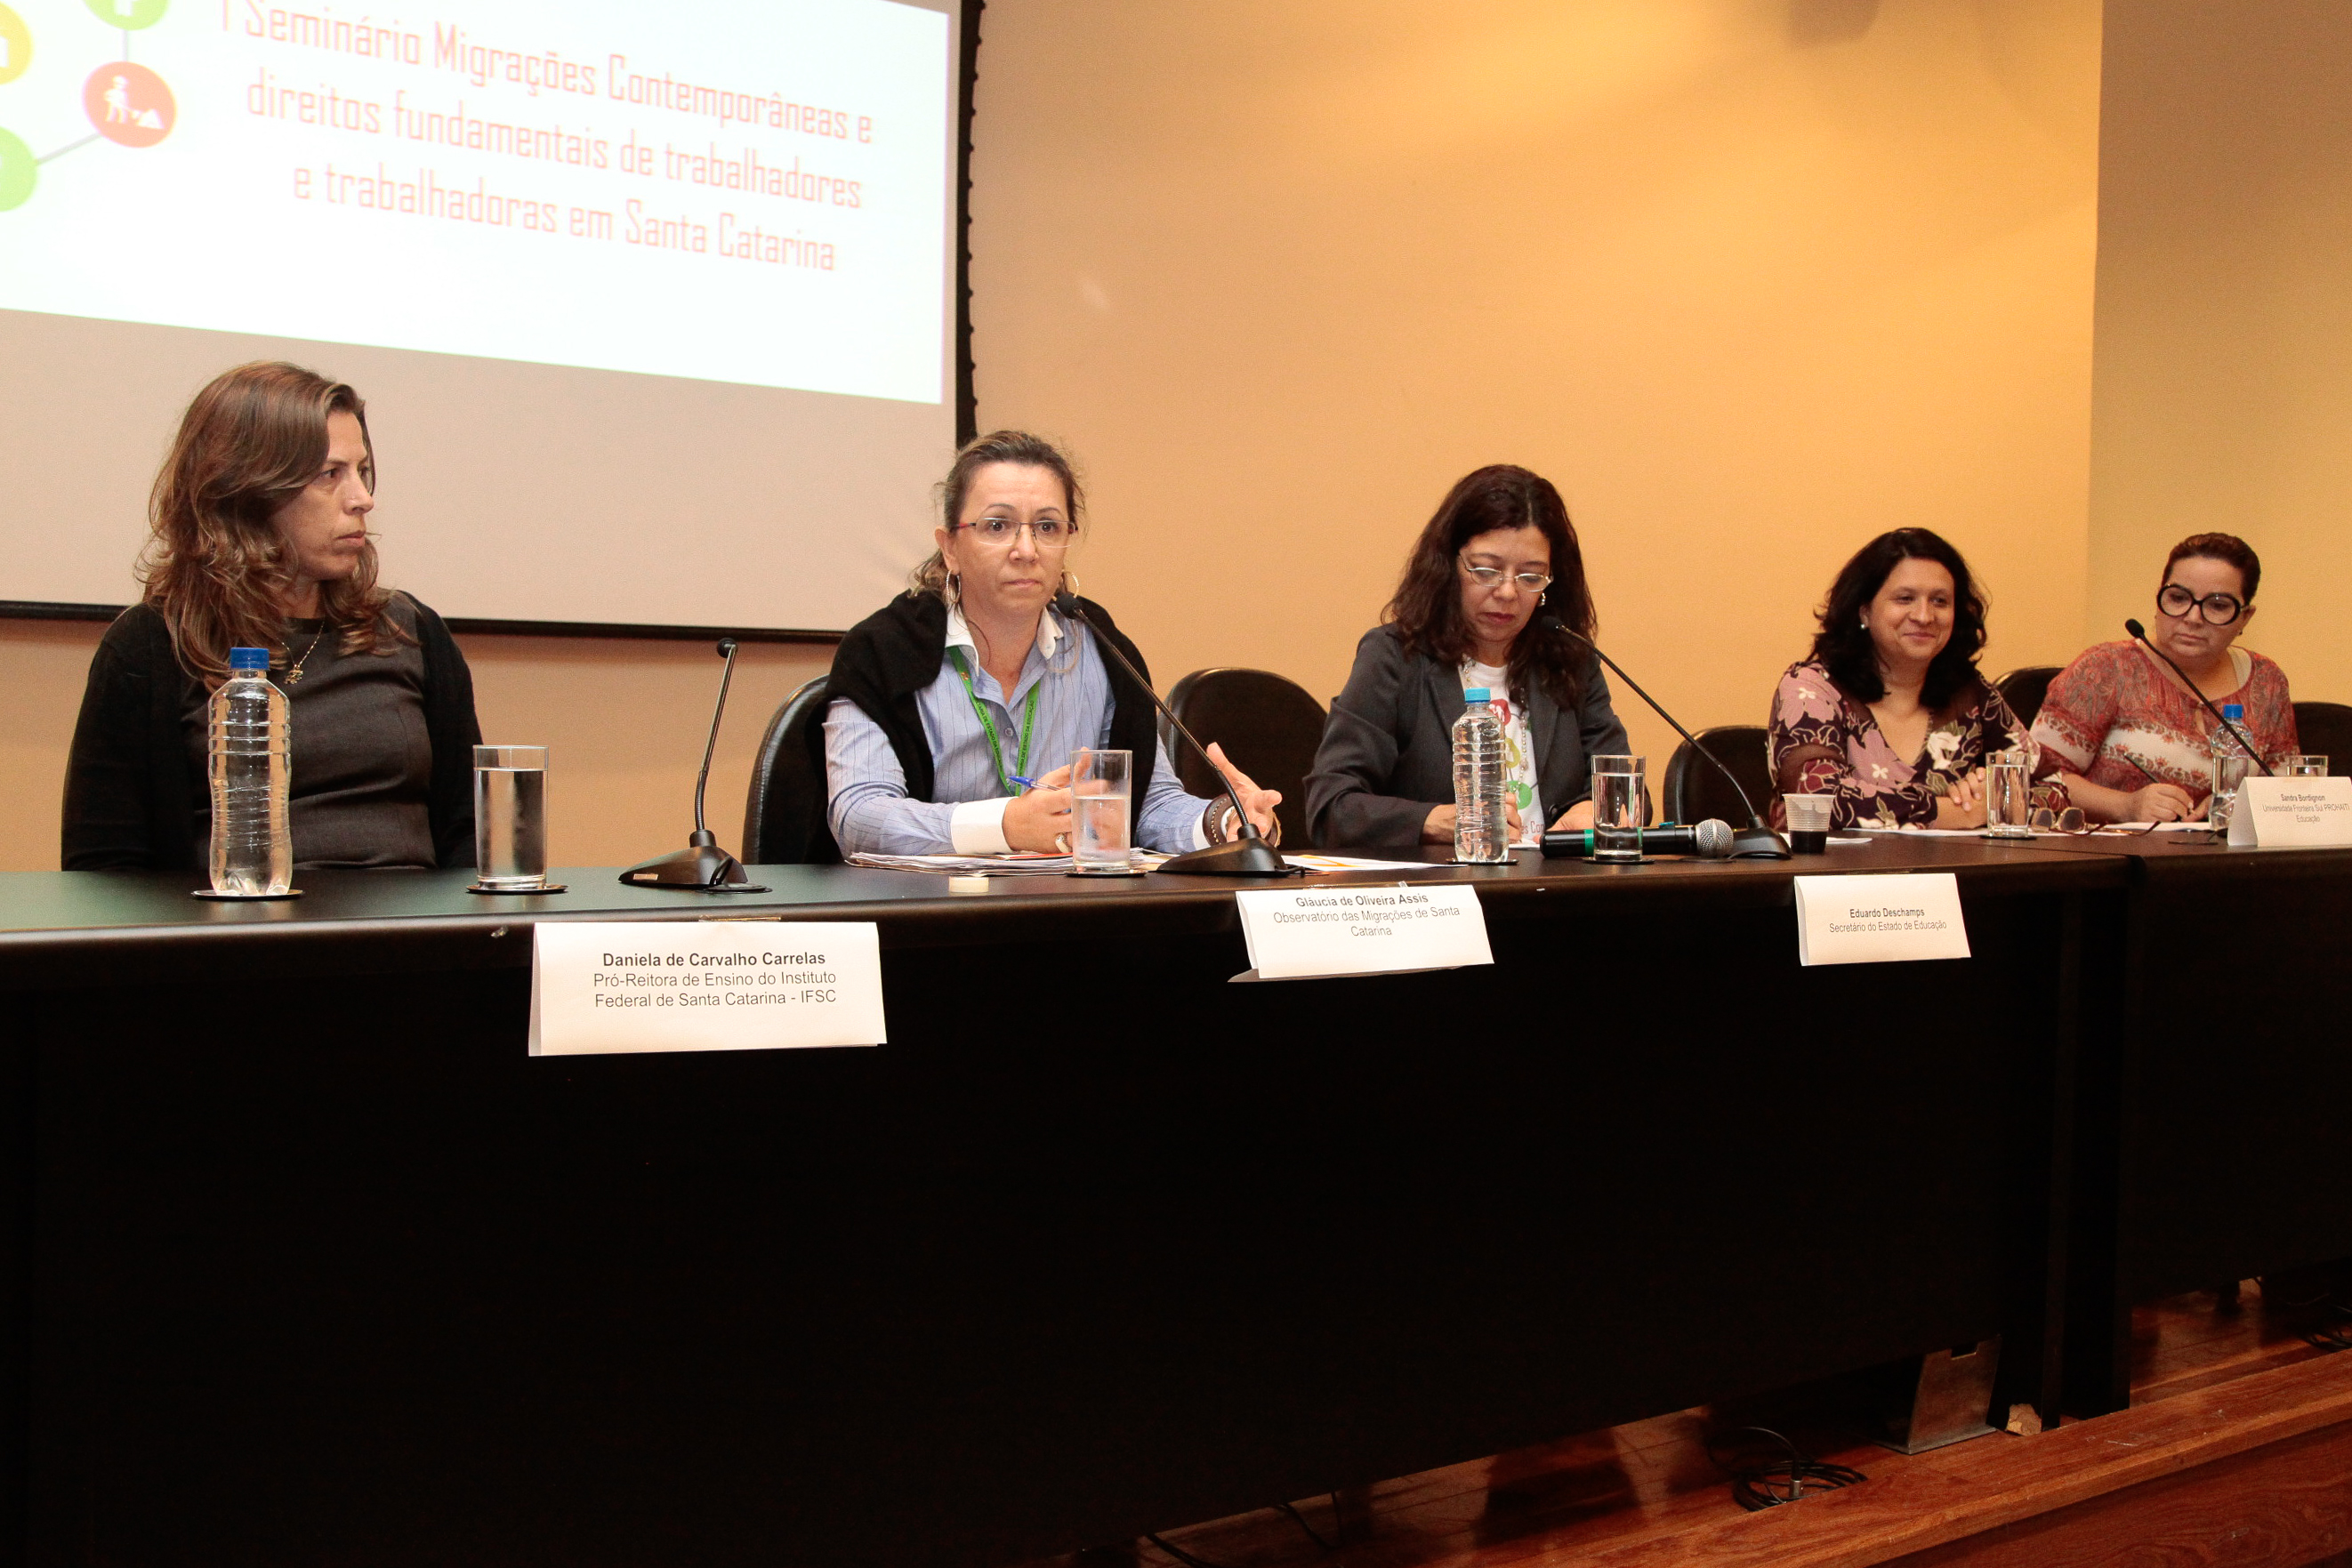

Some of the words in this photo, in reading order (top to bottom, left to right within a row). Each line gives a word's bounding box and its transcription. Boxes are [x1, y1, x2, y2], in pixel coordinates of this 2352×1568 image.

[246, 0, 422, 65] Seminário
[434, 21, 597, 97] Migrações
[609, 53, 850, 140] Contemporâneas
[858, 115, 873, 143] e
[248, 68, 382, 133] direitos
[394, 90, 608, 169] fundamentais
[621, 129, 655, 176] de
[665, 143, 863, 208] trabalhadores
[294, 167, 312, 199] e
[326, 163, 558, 233] trabalhadoras
[569, 207, 614, 240] em
[625, 198, 708, 253] Santa
[718, 213, 837, 271] Catarina
[2280, 793, 2298, 801] Sandra
[2262, 804, 2293, 812] Universidade
[2315, 804, 2323, 812] Sul
[2296, 815, 2321, 824] Educação
[1296, 897, 1337, 907] Gláucia
[1340, 896, 1353, 906] de
[1355, 894, 1396, 905] Oliveira
[1398, 893, 1429, 904] Assis
[1274, 911, 1340, 923] Observatório
[1341, 910, 1360, 921] das
[1362, 909, 1413, 923] Migrações
[1415, 908, 1429, 919] de
[1430, 906, 1461, 917] Santa
[1849, 909, 1881, 918] Eduardo
[1882, 908, 1925, 918] Deschamps
[1350, 925, 1392, 937] Catarina
[1829, 921, 1866, 932] Secretário
[1867, 921, 1877, 931] do
[1878, 921, 1903, 930] Estado
[1904, 921, 1913, 930] de
[1913, 920, 1947, 931] Educação
[603, 953, 661, 967] Daniela
[665, 953, 685, 967] de
[689, 953, 758, 967] Carvalho
[762, 952, 826, 965] Carrelas
[594, 972, 678, 987] Pró-Reitora
[682, 972, 700, 986] de
[705, 972, 753, 986] Ensino
[758, 971, 777, 985] do
[781, 970, 836, 985] Instituto
[595, 993, 651, 1008] Federal
[656, 993, 674, 1007] de
[679, 992, 721, 1006] Santa
[725, 992, 786, 1005] Catarina
[801, 989, 836, 1003] IFSC
